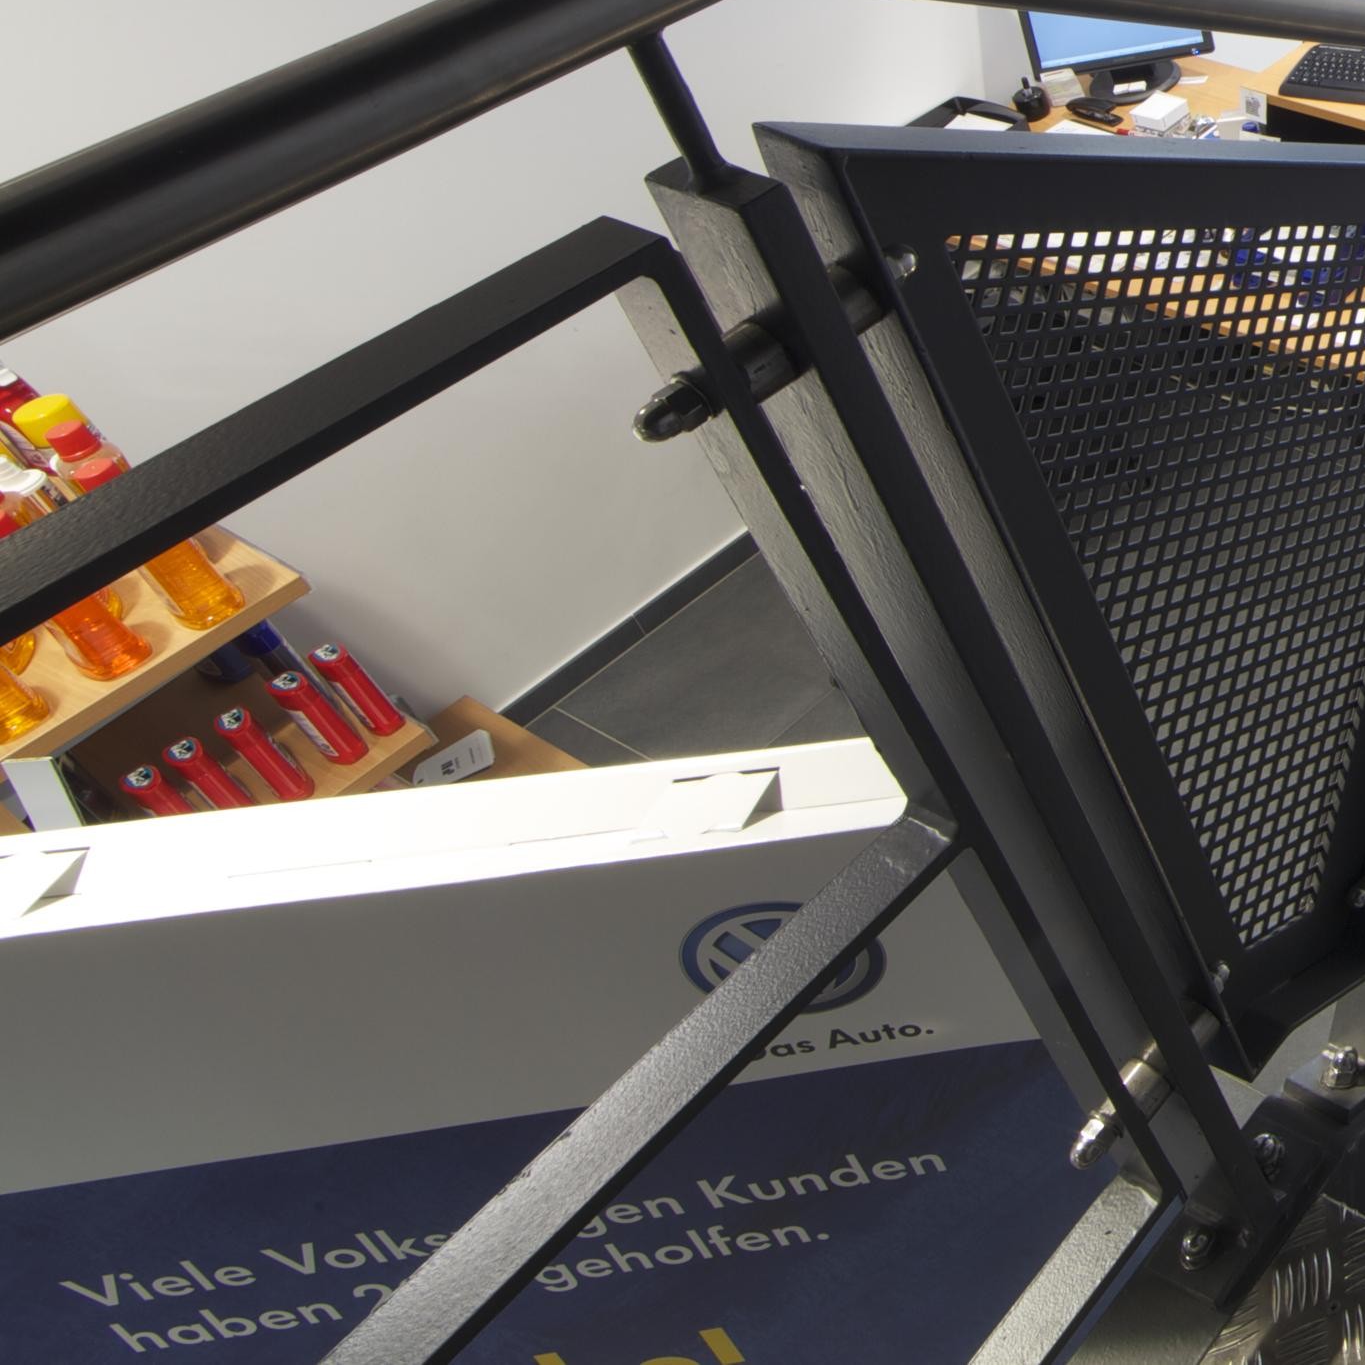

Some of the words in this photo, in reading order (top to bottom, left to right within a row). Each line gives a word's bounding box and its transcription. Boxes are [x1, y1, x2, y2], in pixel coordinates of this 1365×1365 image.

[829, 1024, 935, 1050] Auto.
[58, 1259, 257, 1307] Viele
[697, 1153, 948, 1210] Kunden
[109, 1301, 343, 1354] haben
[534, 1224, 831, 1293] geholfen.
